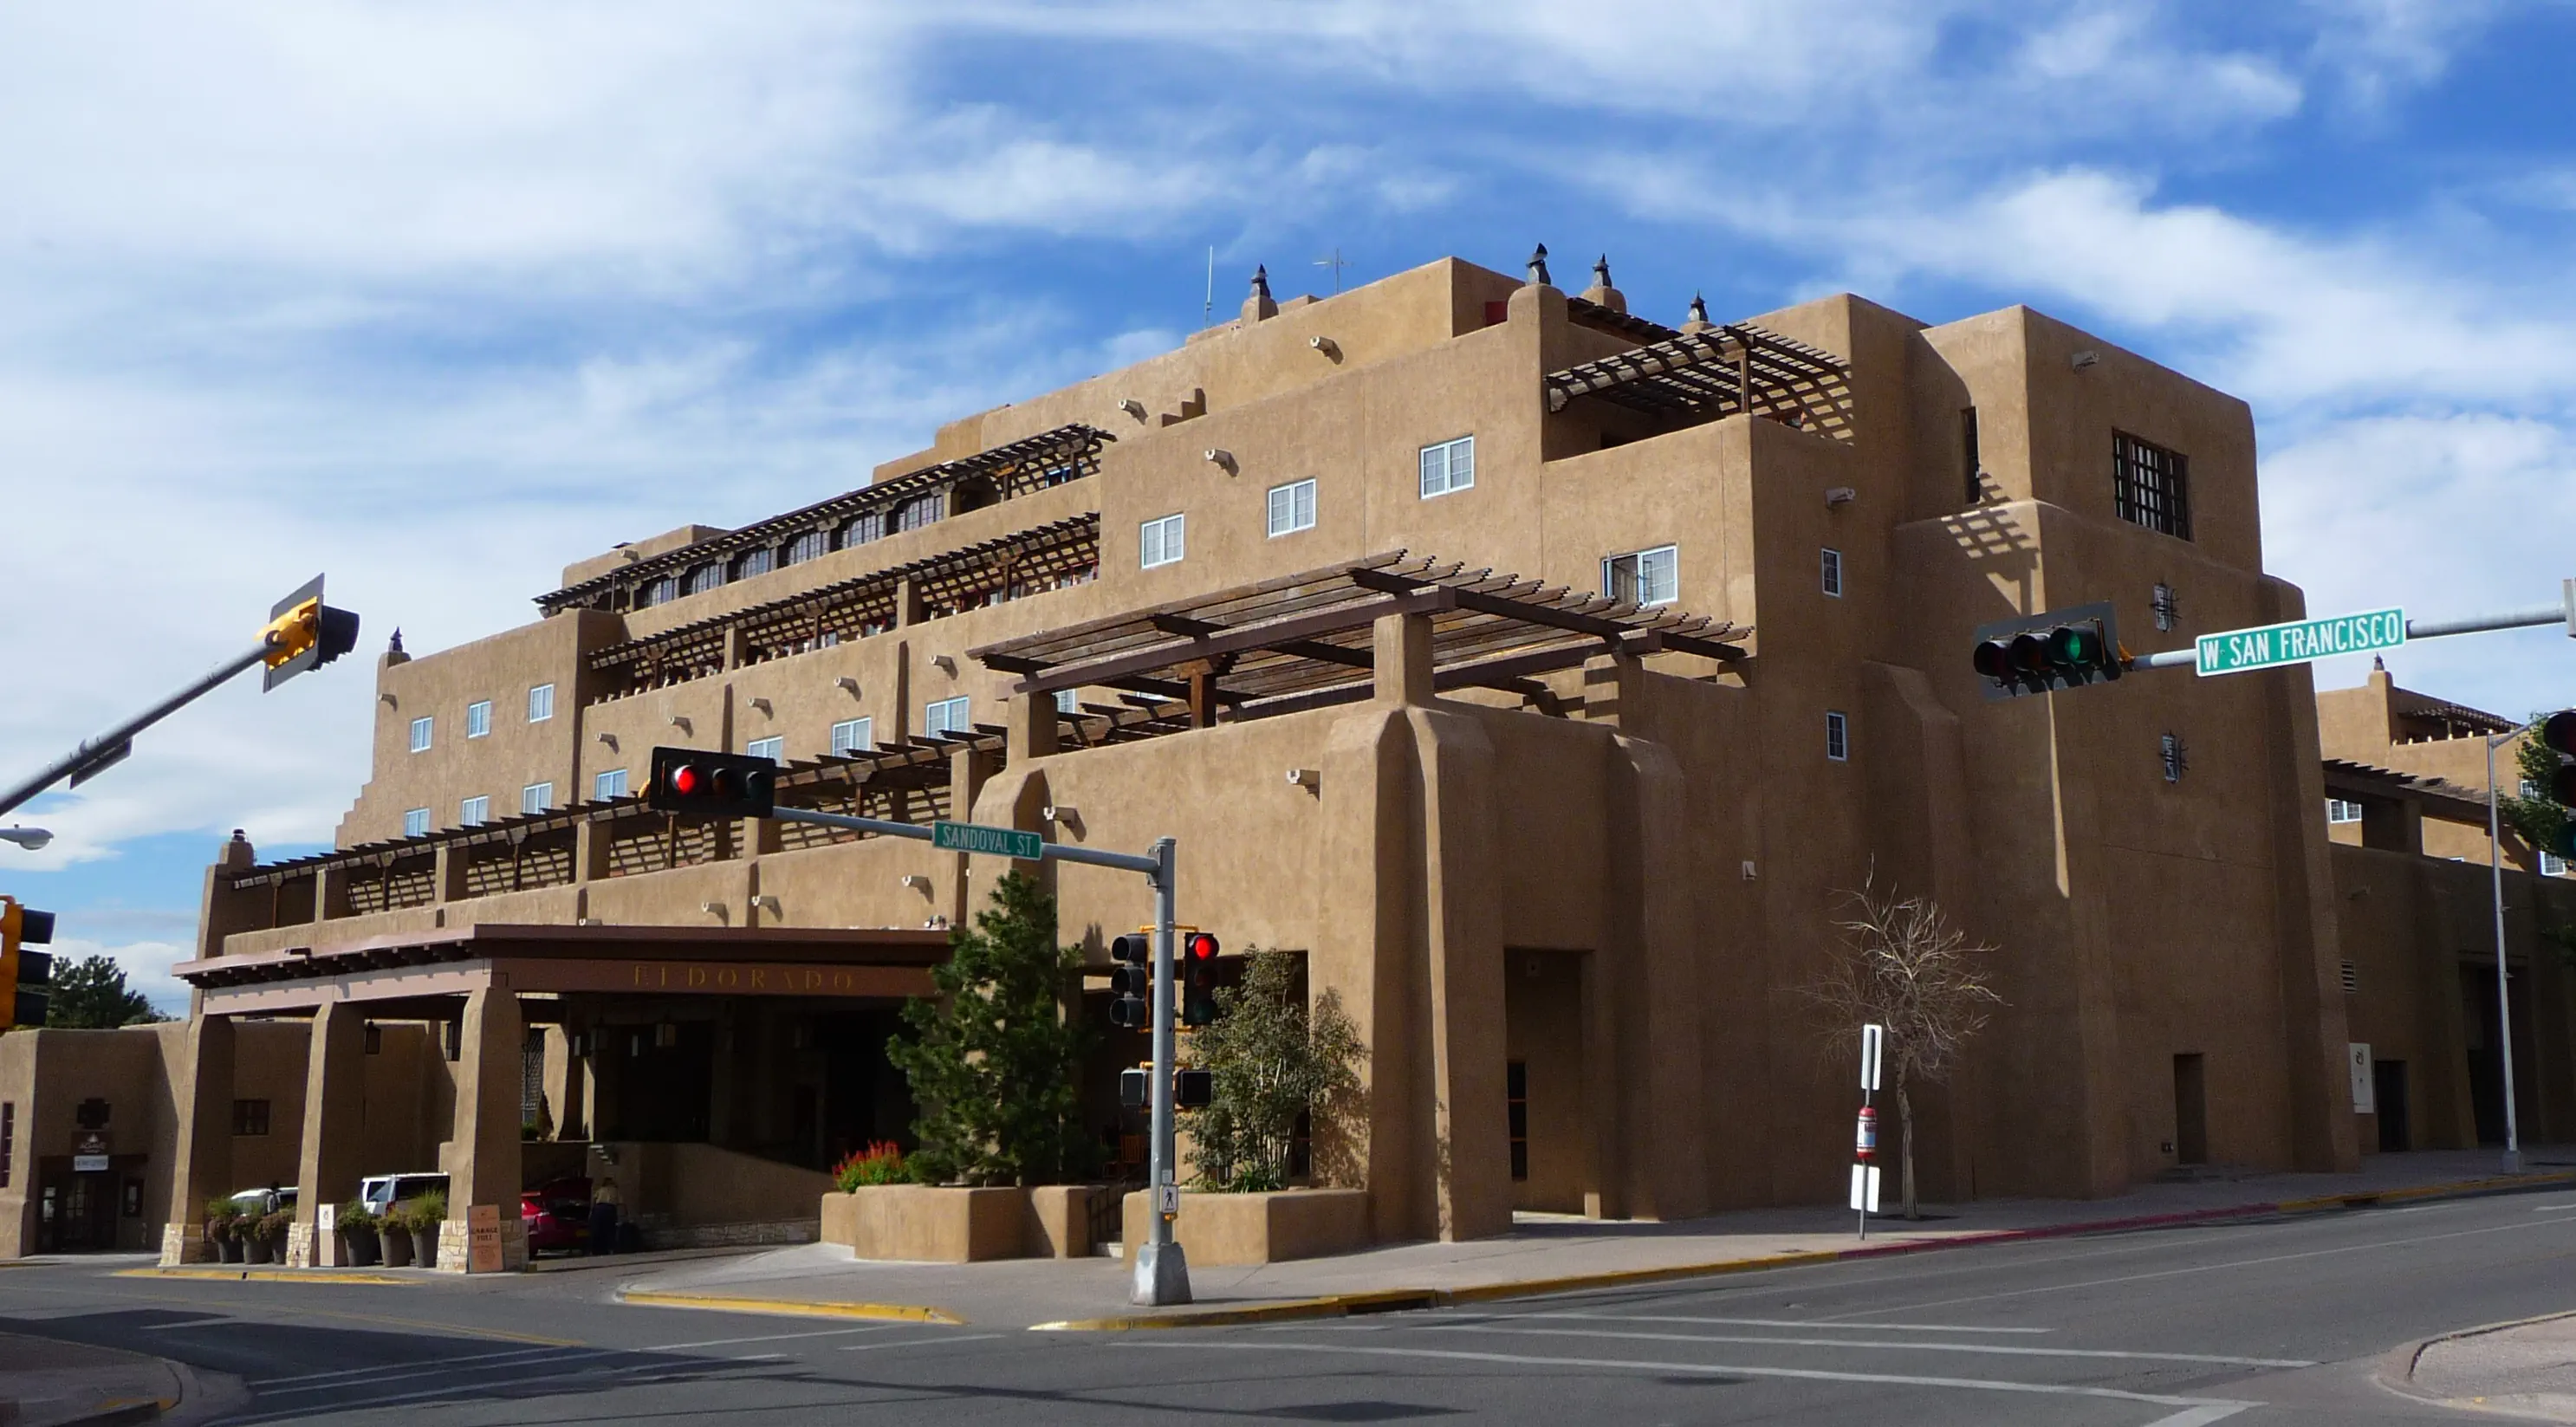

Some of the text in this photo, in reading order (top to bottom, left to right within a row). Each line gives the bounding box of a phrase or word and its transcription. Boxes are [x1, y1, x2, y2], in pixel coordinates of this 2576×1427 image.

[2203, 612, 2399, 670] W SAN FRANCISCO
[943, 826, 1033, 855] SANDOVAL ST
